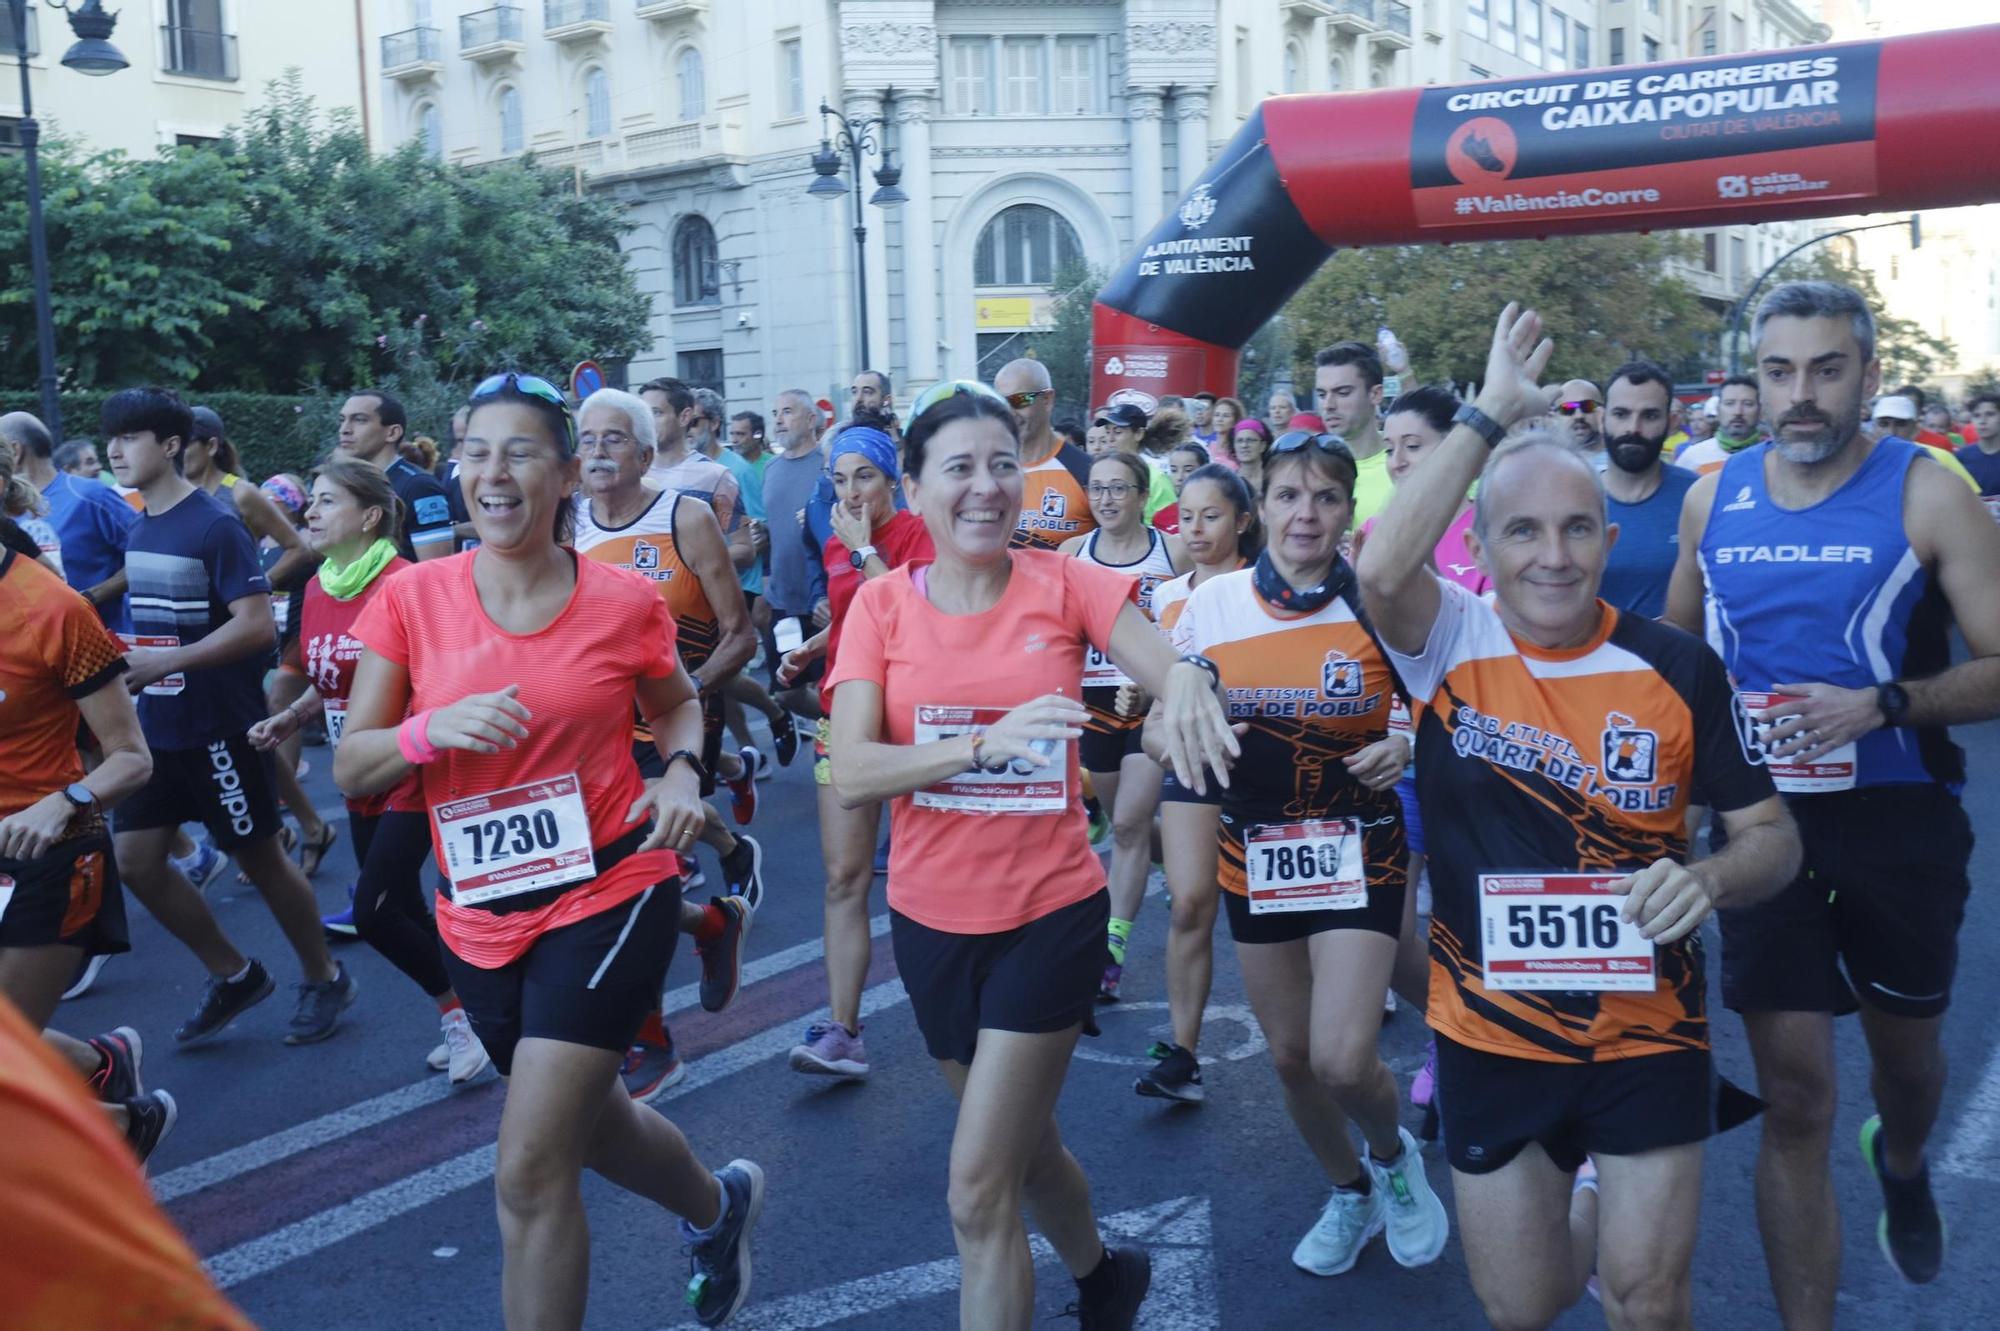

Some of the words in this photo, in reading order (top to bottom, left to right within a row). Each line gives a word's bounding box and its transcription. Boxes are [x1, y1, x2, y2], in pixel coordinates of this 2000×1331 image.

[1447, 83, 1579, 112] CIRCUIT
[1583, 79, 1632, 100] DE
[1636, 57, 1839, 94] CARRERES
[1660, 121, 1717, 141] CIUTAT
[1723, 118, 1749, 135] DE
[1753, 107, 1841, 133] VALÈNCIA
[1750, 172, 1802, 184] caixa
[1454, 186, 1660, 214] #ValènciaCorre
[1143, 236, 1254, 258] AJUNTAMENT
[1138, 261, 1161, 276] DE
[1164, 255, 1255, 275] VALÈNCIA
[1031, 519, 1079, 531] POBLET
[1715, 545, 1873, 564] STADLER
[1265, 702, 1297, 716] DE
[1458, 706, 1499, 733] CLUB
[1454, 726, 1542, 771] QUART
[1548, 757, 1586, 787] DE
[207, 739, 254, 837] adidas
[462, 808, 560, 865] 7230
[1261, 843, 1341, 881] 7860
[1507, 904, 1619, 950] 5516
